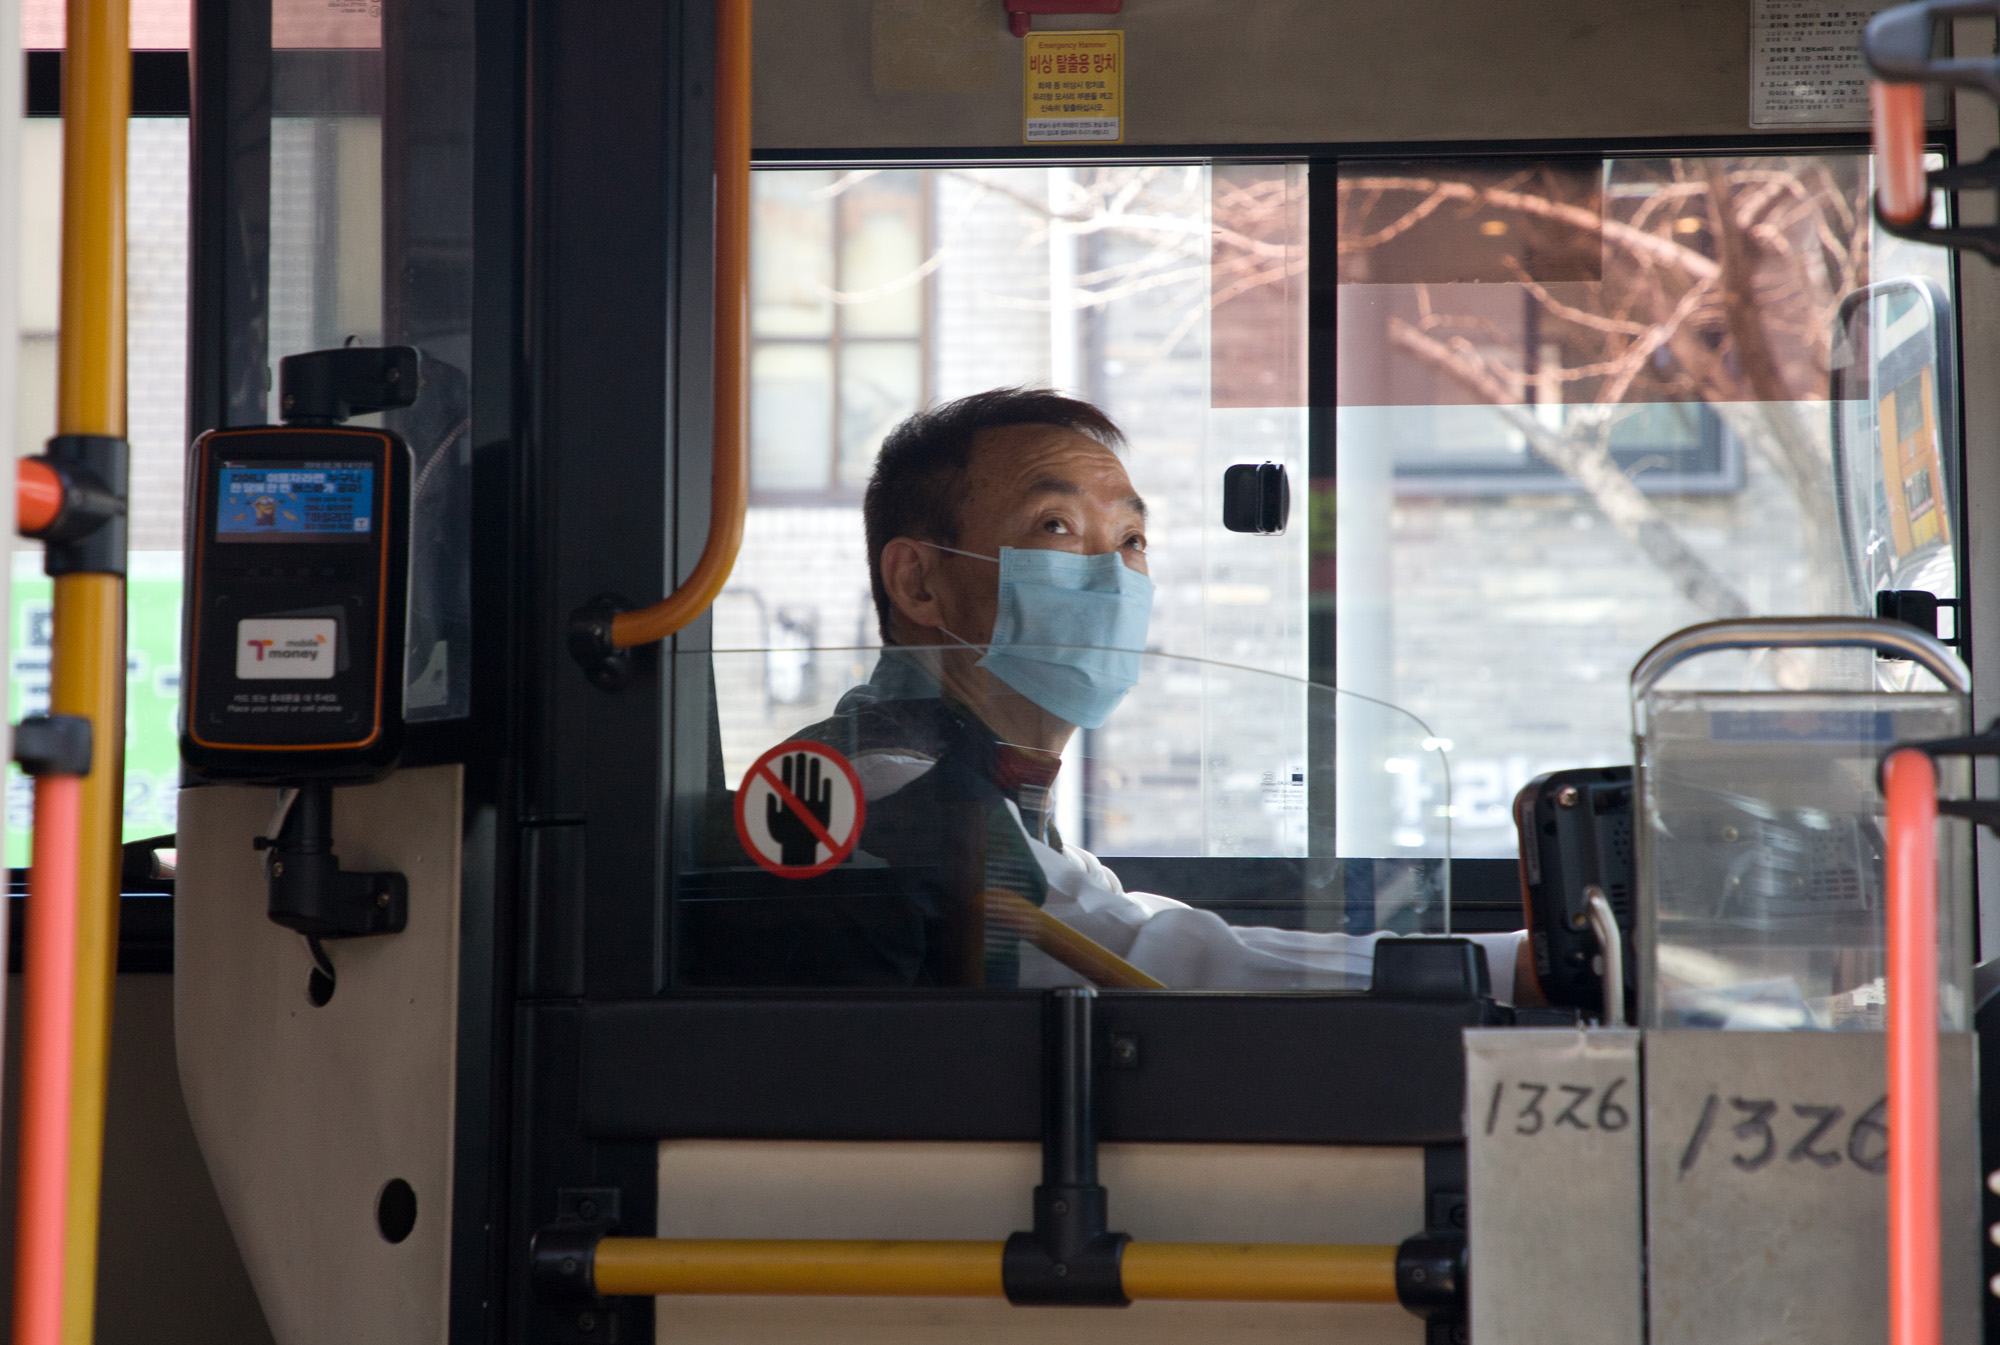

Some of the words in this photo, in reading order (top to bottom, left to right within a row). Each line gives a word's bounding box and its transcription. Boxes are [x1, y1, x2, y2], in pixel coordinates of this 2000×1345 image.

[1038, 42, 1077, 50] Emergency
[1030, 54, 1052, 74] 비상
[1056, 53, 1090, 73] 탈출용
[1094, 53, 1116, 73] 망치
[247, 640, 274, 662] T
[268, 649, 318, 662] money
[316, 705, 343, 713] phone
[1486, 1078, 1630, 1136] 1326
